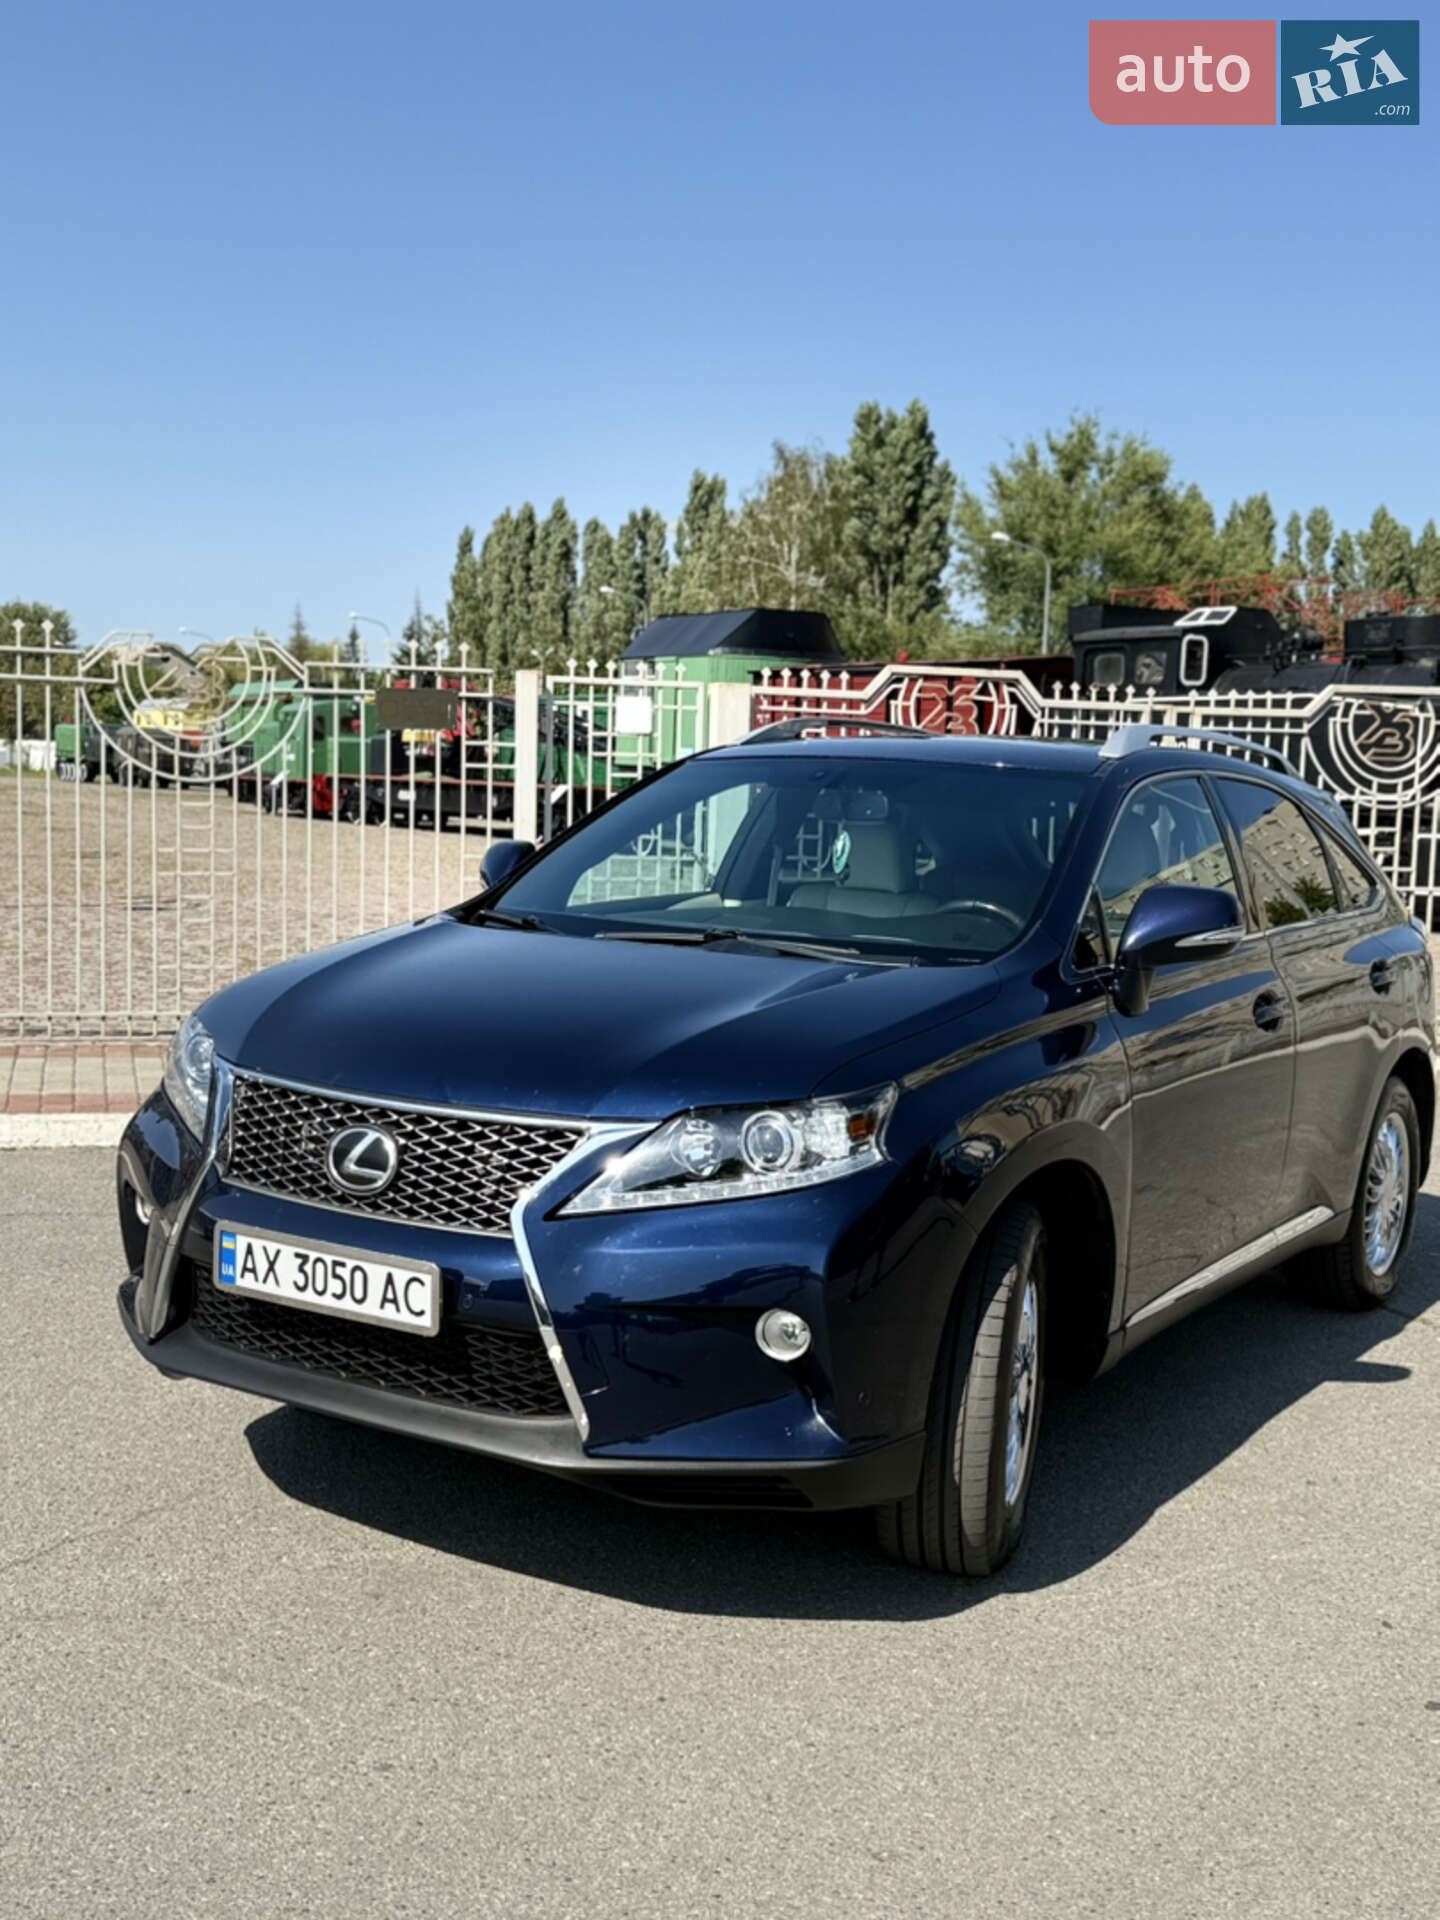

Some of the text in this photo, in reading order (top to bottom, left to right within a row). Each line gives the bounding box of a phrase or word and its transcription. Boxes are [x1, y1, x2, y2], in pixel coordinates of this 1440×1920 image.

[221, 1263, 234, 1275] UA
[240, 1242, 426, 1317] AX 3050 AC
